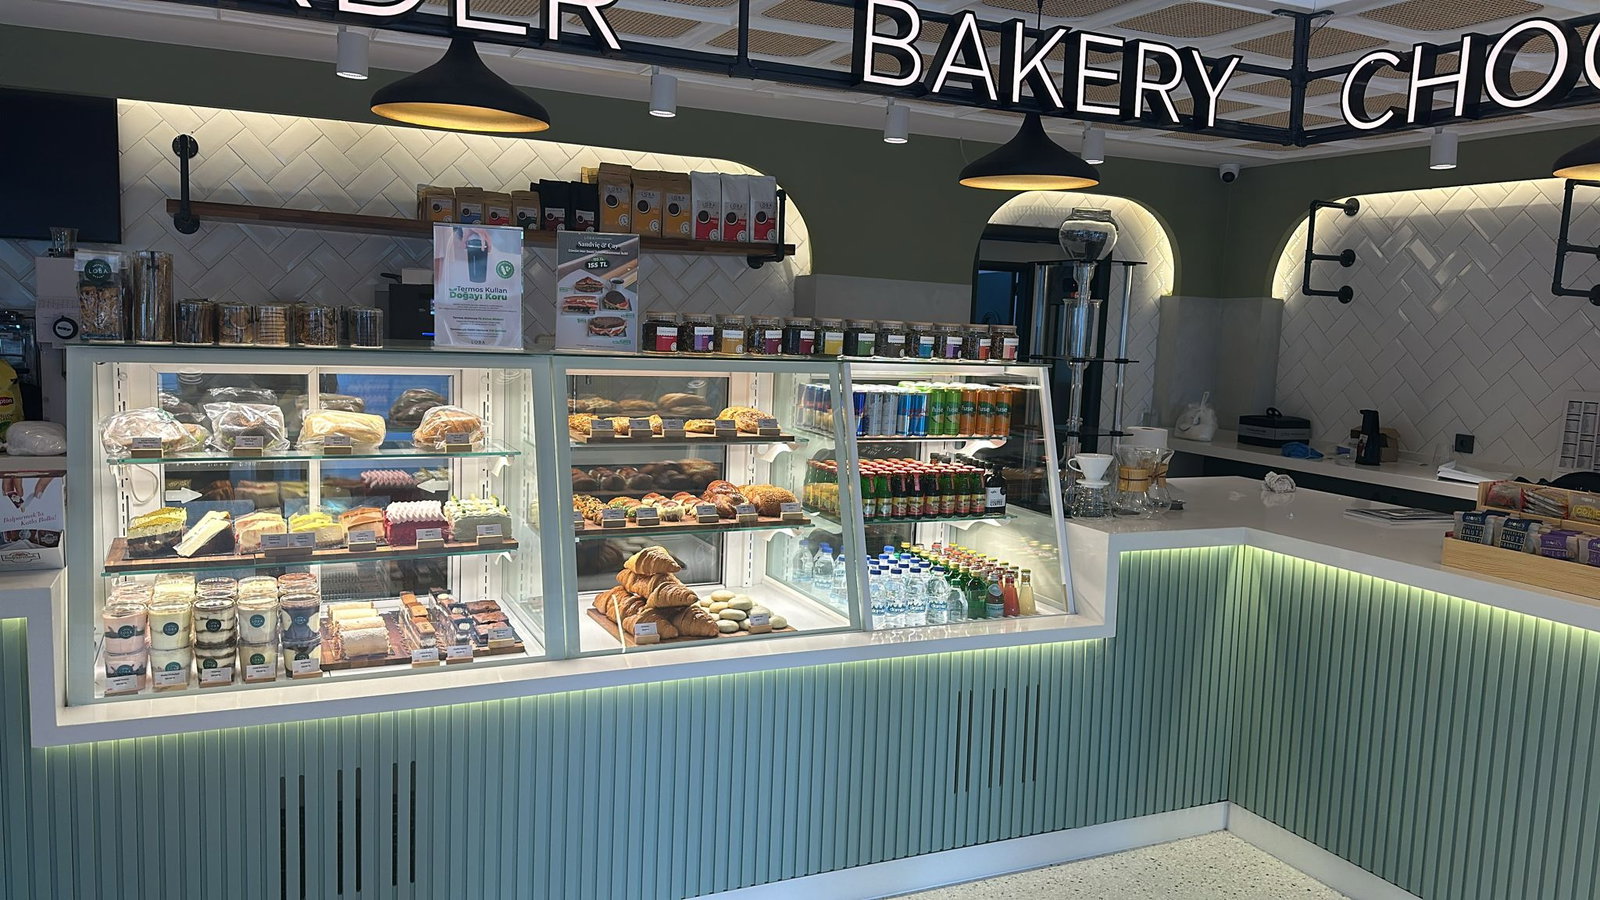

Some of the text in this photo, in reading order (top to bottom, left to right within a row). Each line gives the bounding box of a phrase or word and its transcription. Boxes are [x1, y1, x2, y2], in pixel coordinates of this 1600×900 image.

[863, 0, 1239, 127] BAKERY
[1341, 20, 1600, 129] CHO
[449, 291, 508, 301] Doğayı Koru
[457, 285, 484, 293] Termos
